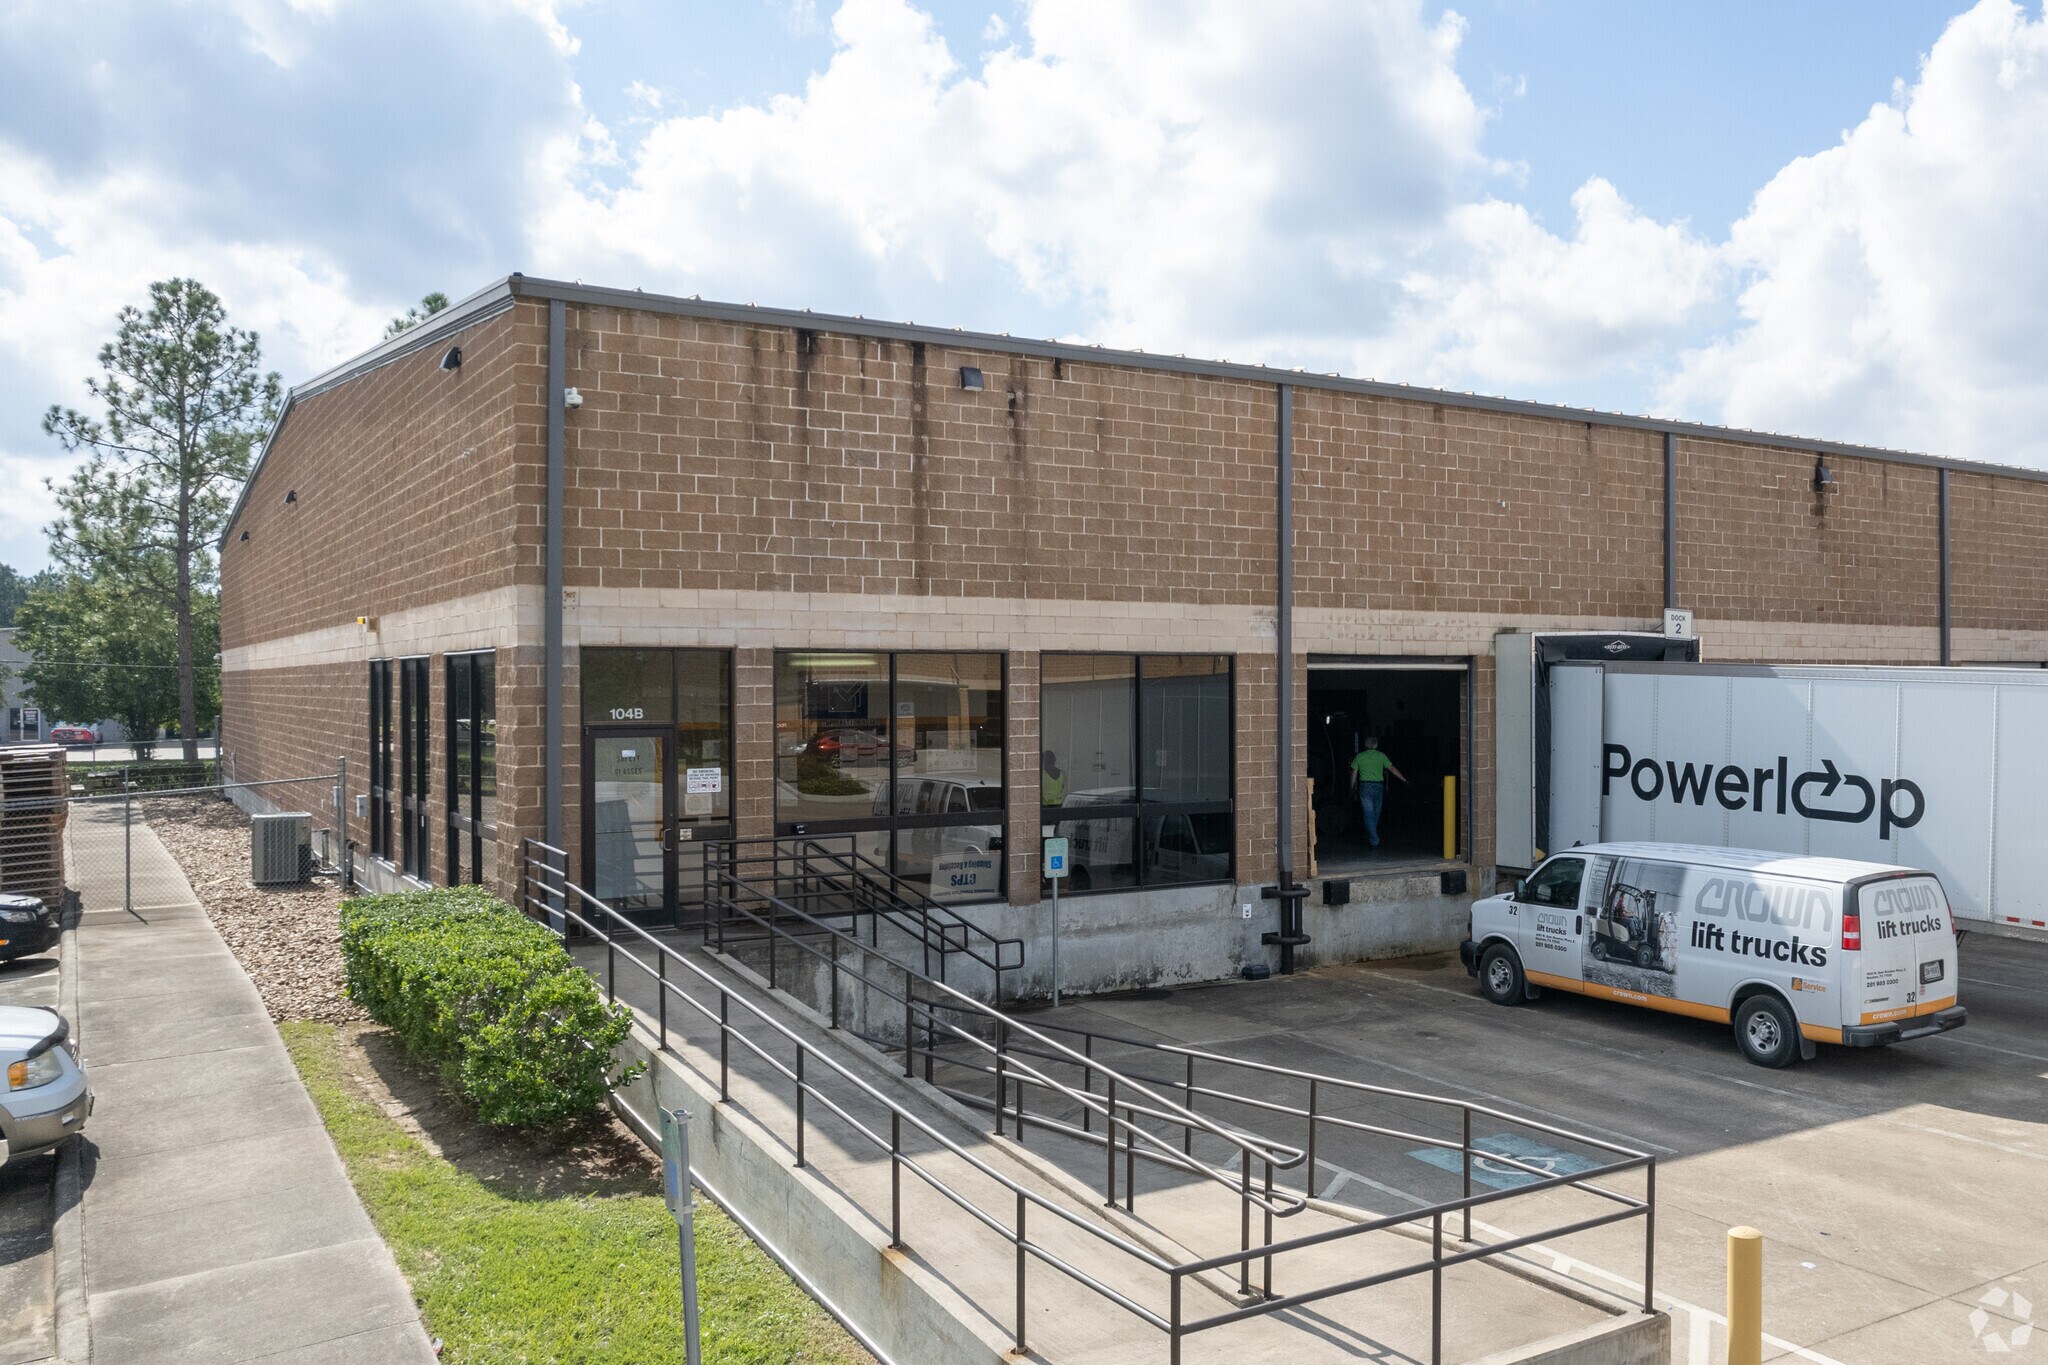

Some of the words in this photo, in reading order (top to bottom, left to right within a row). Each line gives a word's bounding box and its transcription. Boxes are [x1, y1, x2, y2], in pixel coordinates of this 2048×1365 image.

[1670, 614, 1686, 622] DOCK
[1675, 623, 1682, 634] 2
[609, 708, 644, 720] 104B
[614, 767, 642, 777] GLASSES
[938, 861, 964, 871] Receiving
[969, 859, 992, 869] Shipping
[951, 873, 977, 887] CTPS
[1508, 905, 1518, 916] 32
[1536, 923, 1546, 932] lift
[1546, 925, 1567, 936] trucks
[1877, 919, 1898, 940] lift
[1900, 914, 1942, 936] trucks
[1691, 920, 1725, 952] lift
[1731, 929, 1828, 967] trucks
[1803, 981, 1827, 993] Service
[1612, 989, 1648, 1002] crown.com
[1906, 991, 1916, 1003] 32
[1872, 1009, 1907, 1020] crown.com
